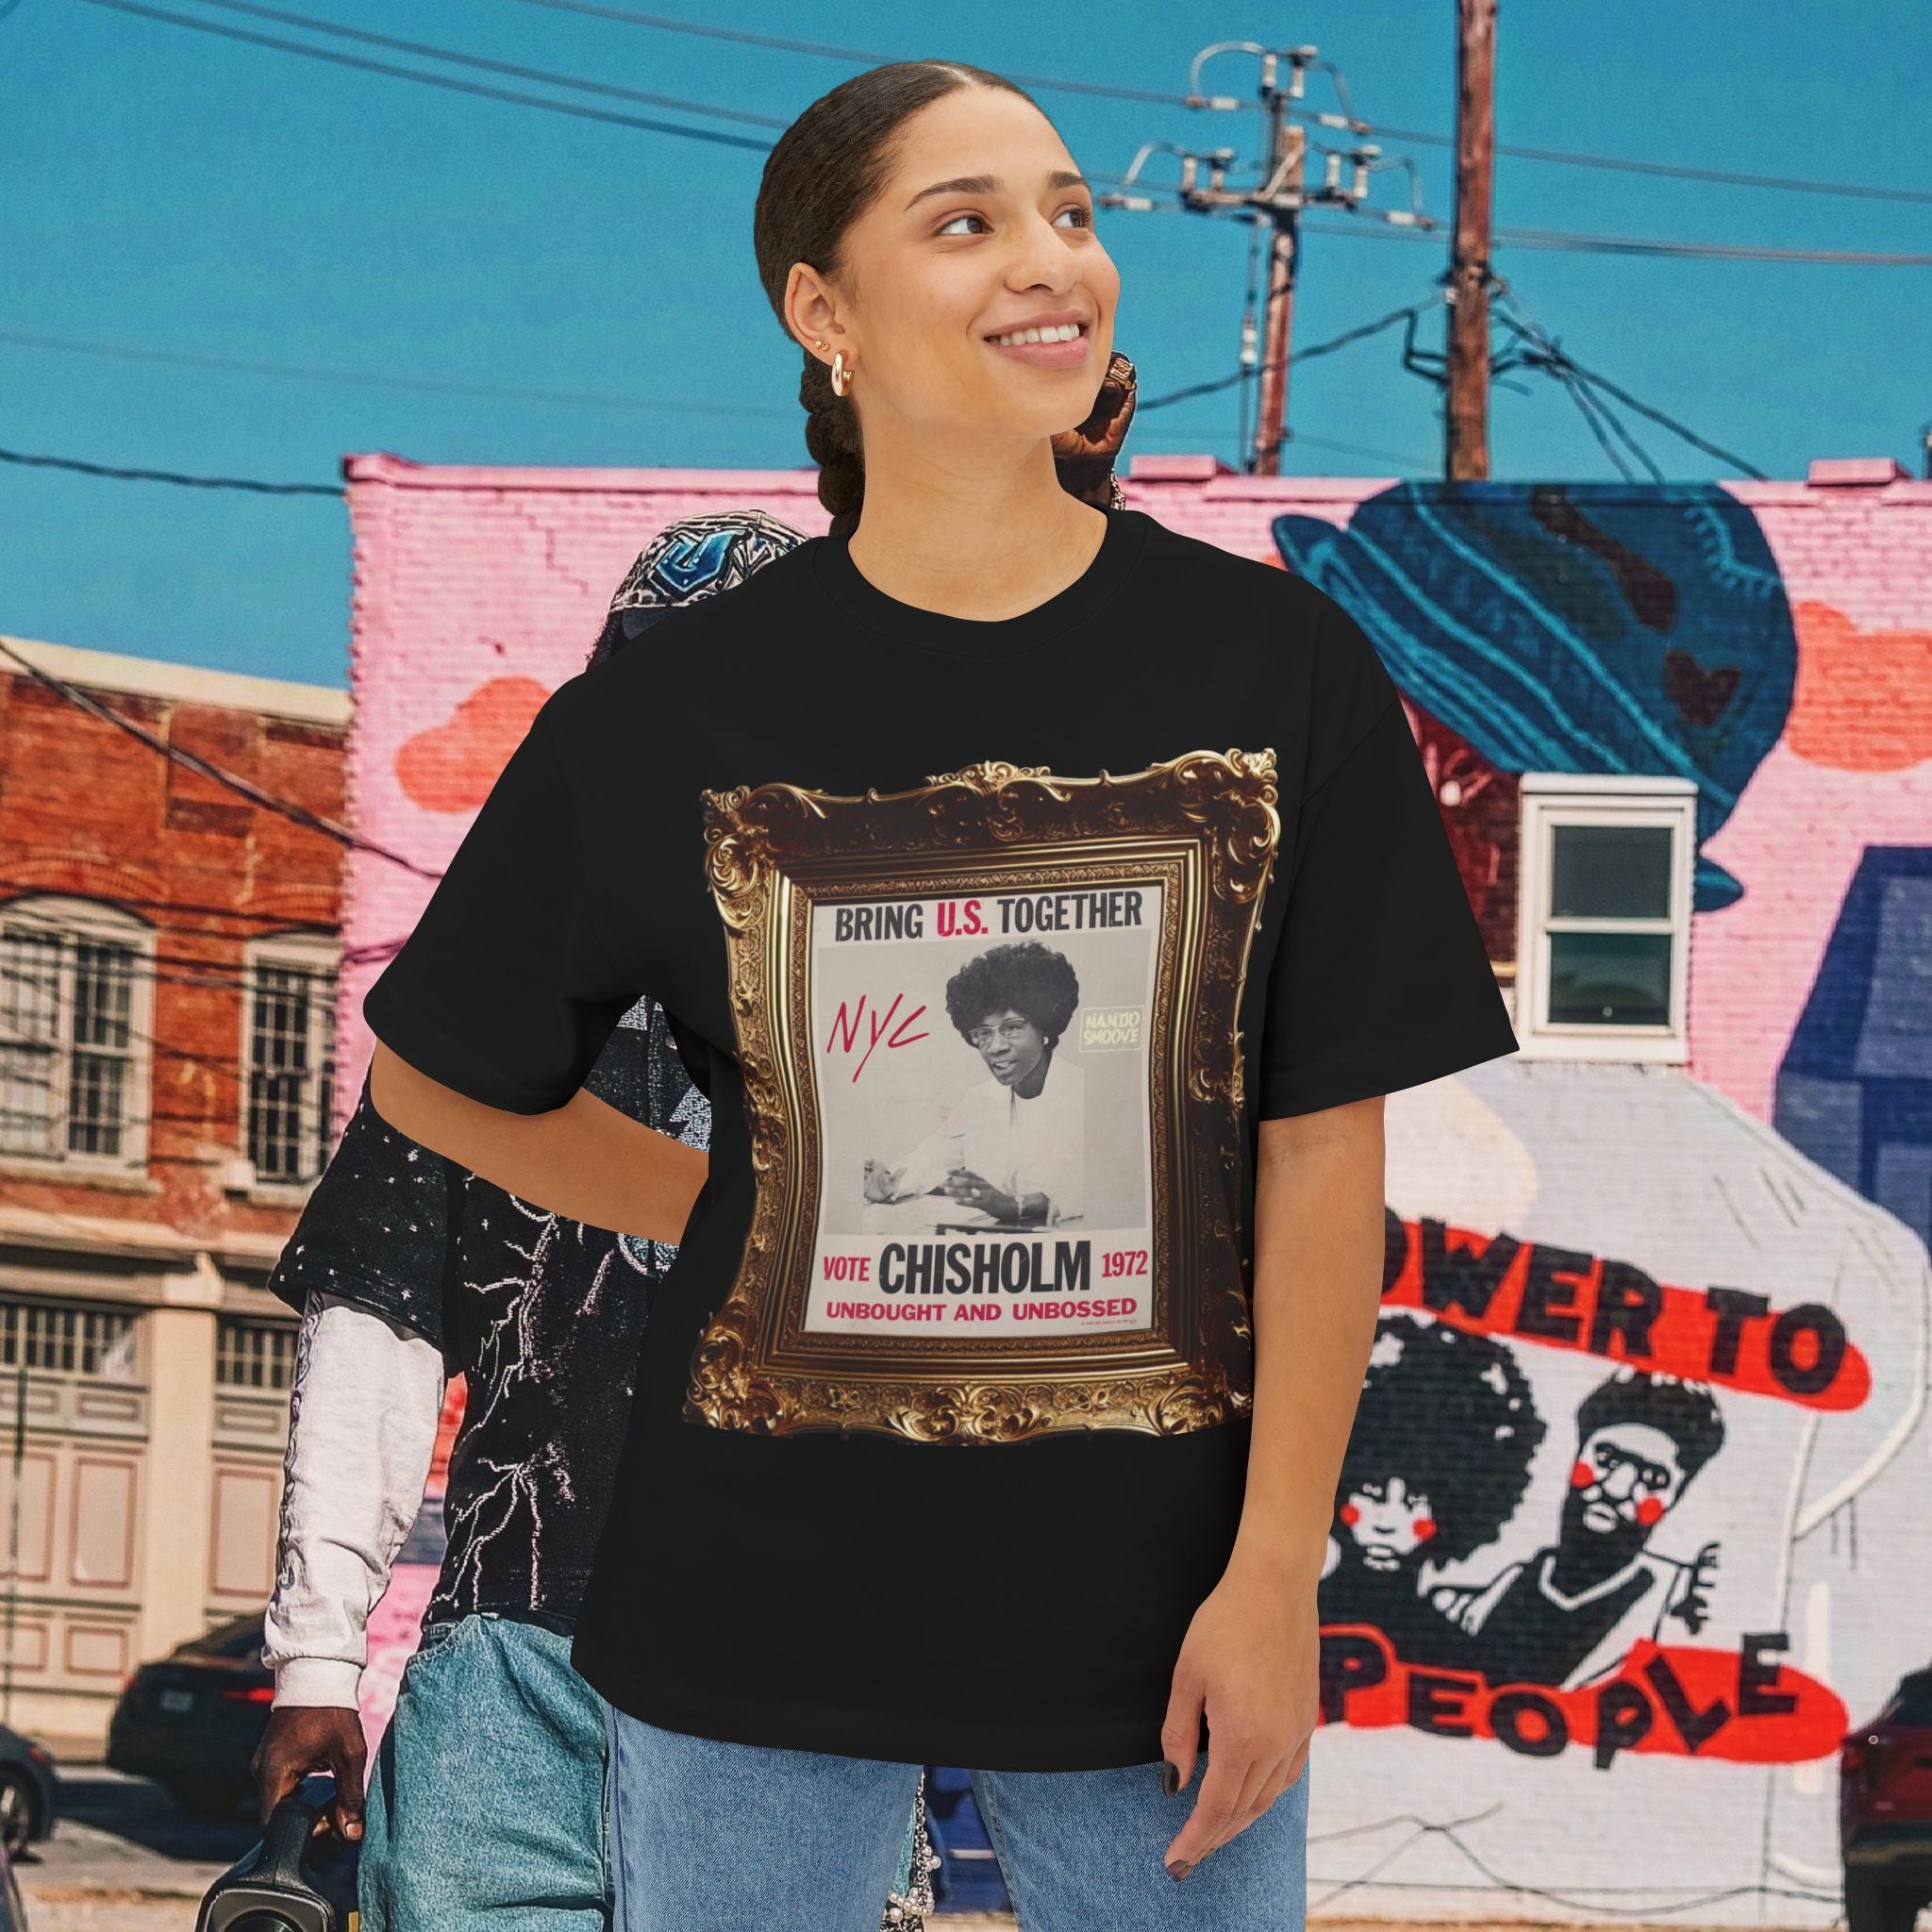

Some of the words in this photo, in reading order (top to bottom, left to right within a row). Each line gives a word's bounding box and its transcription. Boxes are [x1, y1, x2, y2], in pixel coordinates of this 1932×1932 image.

[835, 903, 924, 942] BRING
[937, 899, 989, 937] U.S.
[997, 890, 1143, 934] TOGETHER
[826, 993, 930, 1084] NYC
[1083, 1026, 1139, 1046] SMOOVE
[824, 1256, 871, 1282] VOTE
[878, 1240, 1091, 1295] CHISHOLM
[1101, 1250, 1148, 1278] 1972
[825, 1301, 947, 1322] UNBOUGHT
[953, 1304, 1002, 1322] AND
[1012, 1297, 1138, 1321] UNBOSSED
[1706, 1286, 1848, 1395] TO
[1319, 1633, 1799, 1770] PEOPLE
